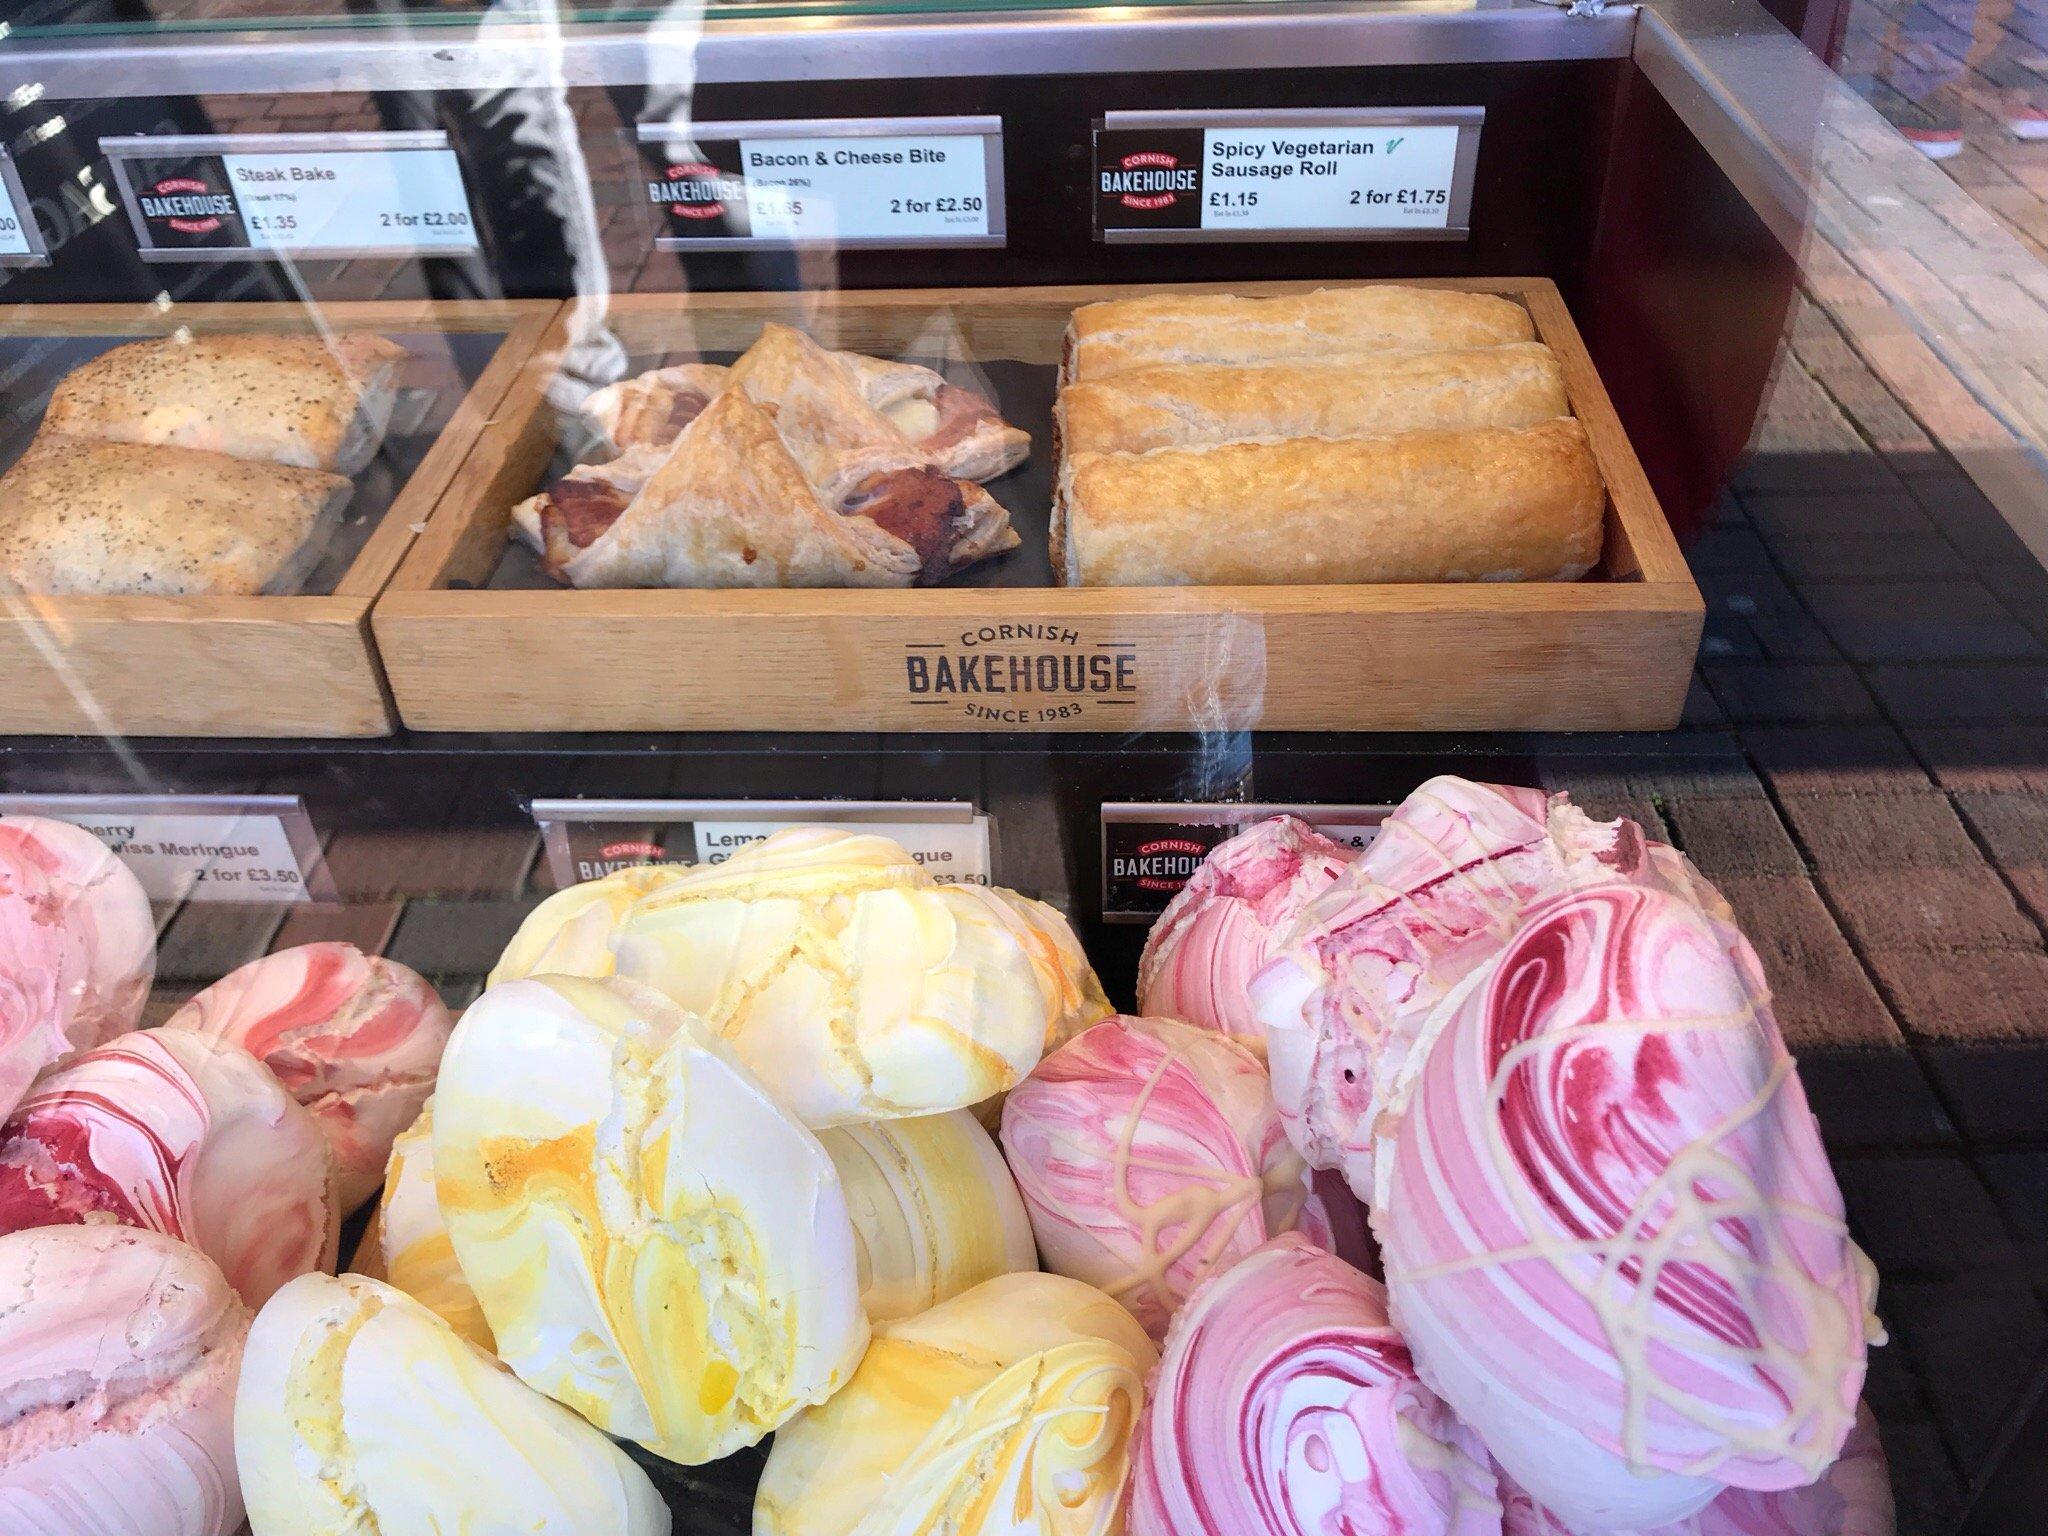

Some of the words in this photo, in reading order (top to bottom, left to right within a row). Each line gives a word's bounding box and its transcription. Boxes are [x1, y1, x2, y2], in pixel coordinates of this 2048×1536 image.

[1212, 141, 1265, 159] Spicy
[1272, 139, 1374, 158] Vegetarian
[750, 152, 809, 166] Bacon
[815, 152, 828, 165] &
[834, 149, 903, 164] Cheese
[909, 149, 946, 163] Bite
[1124, 154, 1174, 168] CORNISH
[236, 167, 286, 182] Steak
[290, 166, 336, 180] Bake
[1211, 162, 1292, 179] Sausage
[1300, 160, 1337, 175] Roll
[1101, 170, 1197, 192] BAKEHOUSE
[648, 181, 743, 202] BAKEHOUSE
[1210, 192, 1258, 206] £1.15
[1350, 190, 1360, 204] 2
[1366, 189, 1392, 204] for
[1397, 189, 1446, 204] £1.75
[141, 195, 236, 217] BAKEHOUSE
[891, 199, 901, 213] 2
[906, 199, 931, 213] for
[936, 197, 982, 211] £2.50
[251, 215, 297, 230] £1.35
[380, 214, 391, 227] 2
[396, 213, 419, 226] for
[424, 213, 468, 226] £2.00
[961, 623, 1079, 647] CORNISH
[906, 655, 1137, 693] BAKEHOUSE
[964, 703, 1030, 723] SINCE
[1037, 702, 1083, 722] 1983
[706, 832, 768, 847] Lemo
[1141, 841, 1201, 854] CORNISH
[159, 841, 259, 859] Meringue
[912, 851, 952, 865] gue
[195, 870, 205, 881] 2
[213, 869, 241, 881] for
[247, 870, 299, 883] £3.50
[933, 874, 987, 886] £350
[1140, 878, 1173, 889] SINCE
